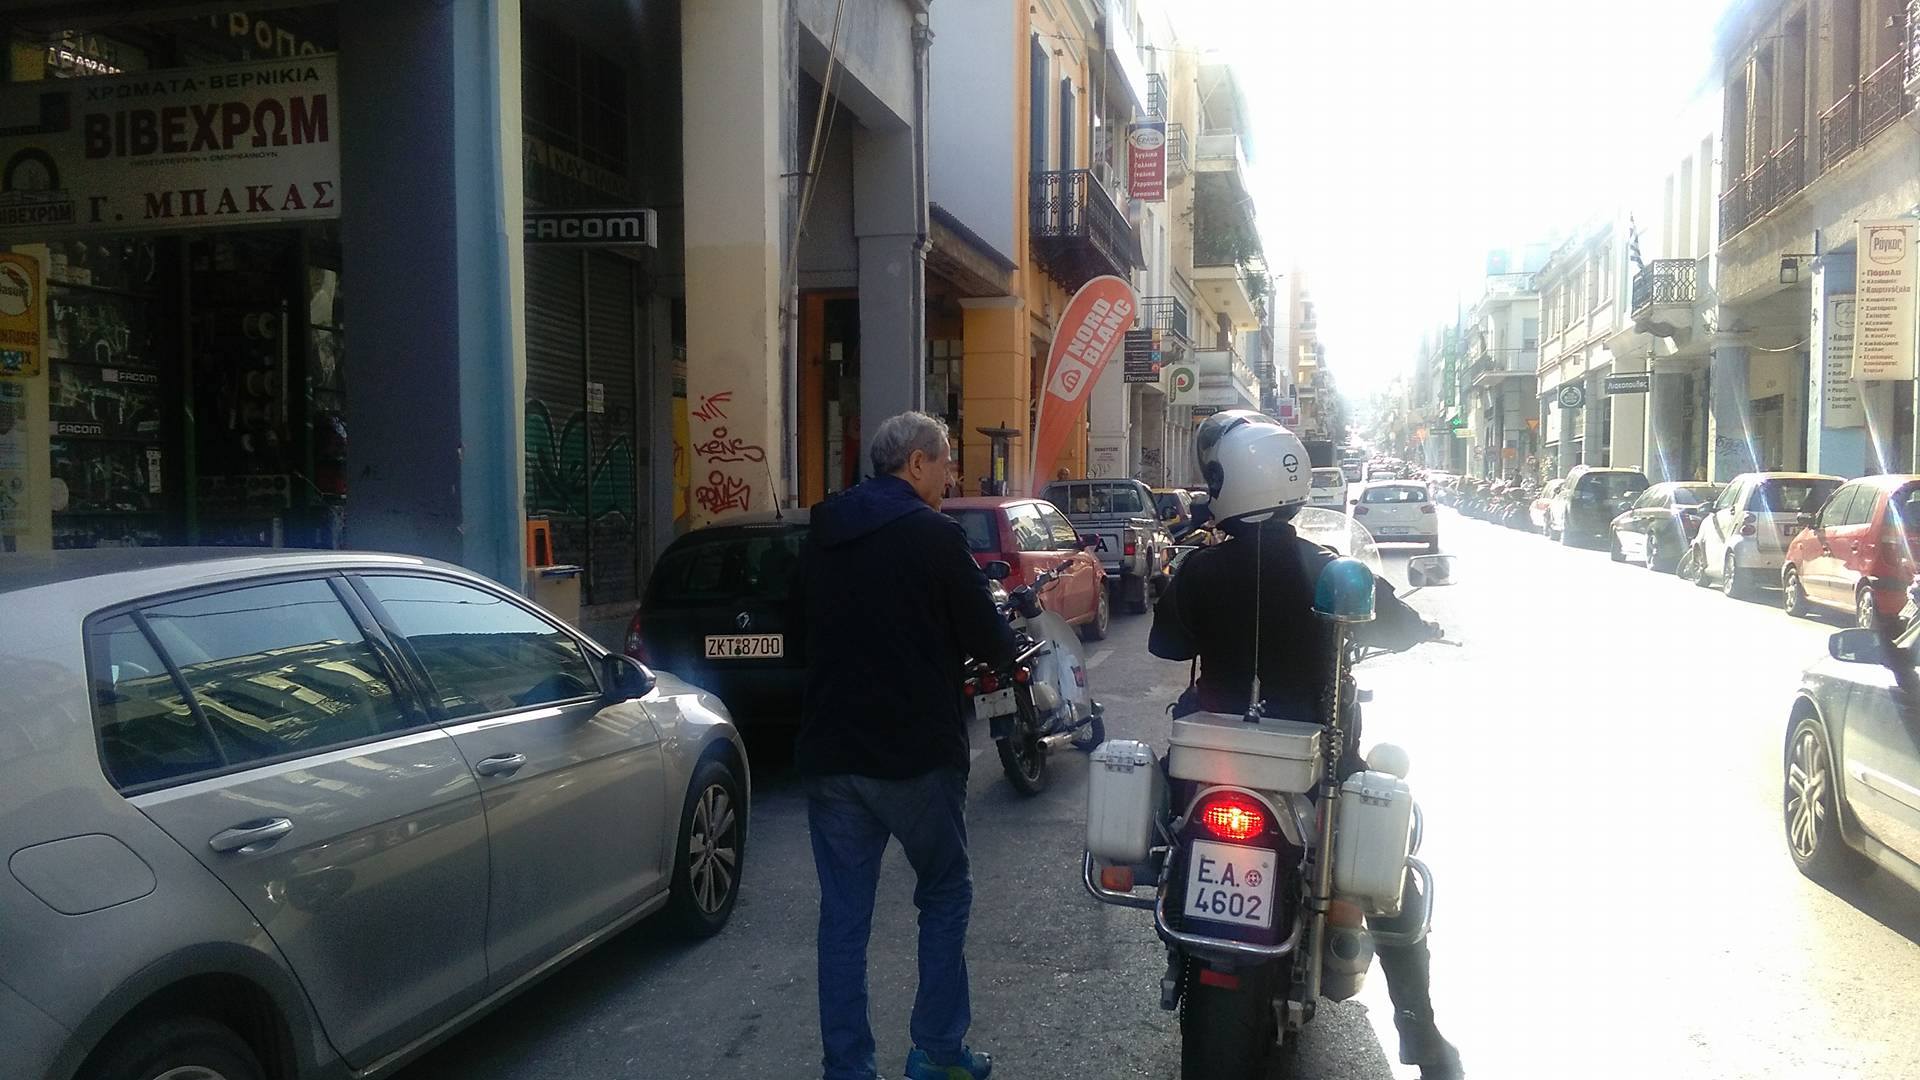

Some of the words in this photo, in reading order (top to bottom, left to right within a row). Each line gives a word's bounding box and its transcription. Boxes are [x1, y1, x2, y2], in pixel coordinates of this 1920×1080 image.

[84, 94, 329, 159] ΒΙΒΕΧΡΩΜ
[89, 195, 125, 223] Γ.
[143, 181, 335, 220] ΜΠΑΚΑΣ
[1067, 298, 1111, 357] NORD
[1082, 299, 1131, 366] BLANC
[119, 372, 158, 383] FACOM
[59, 424, 102, 435] FACOM
[1194, 887, 1263, 921] 4602
